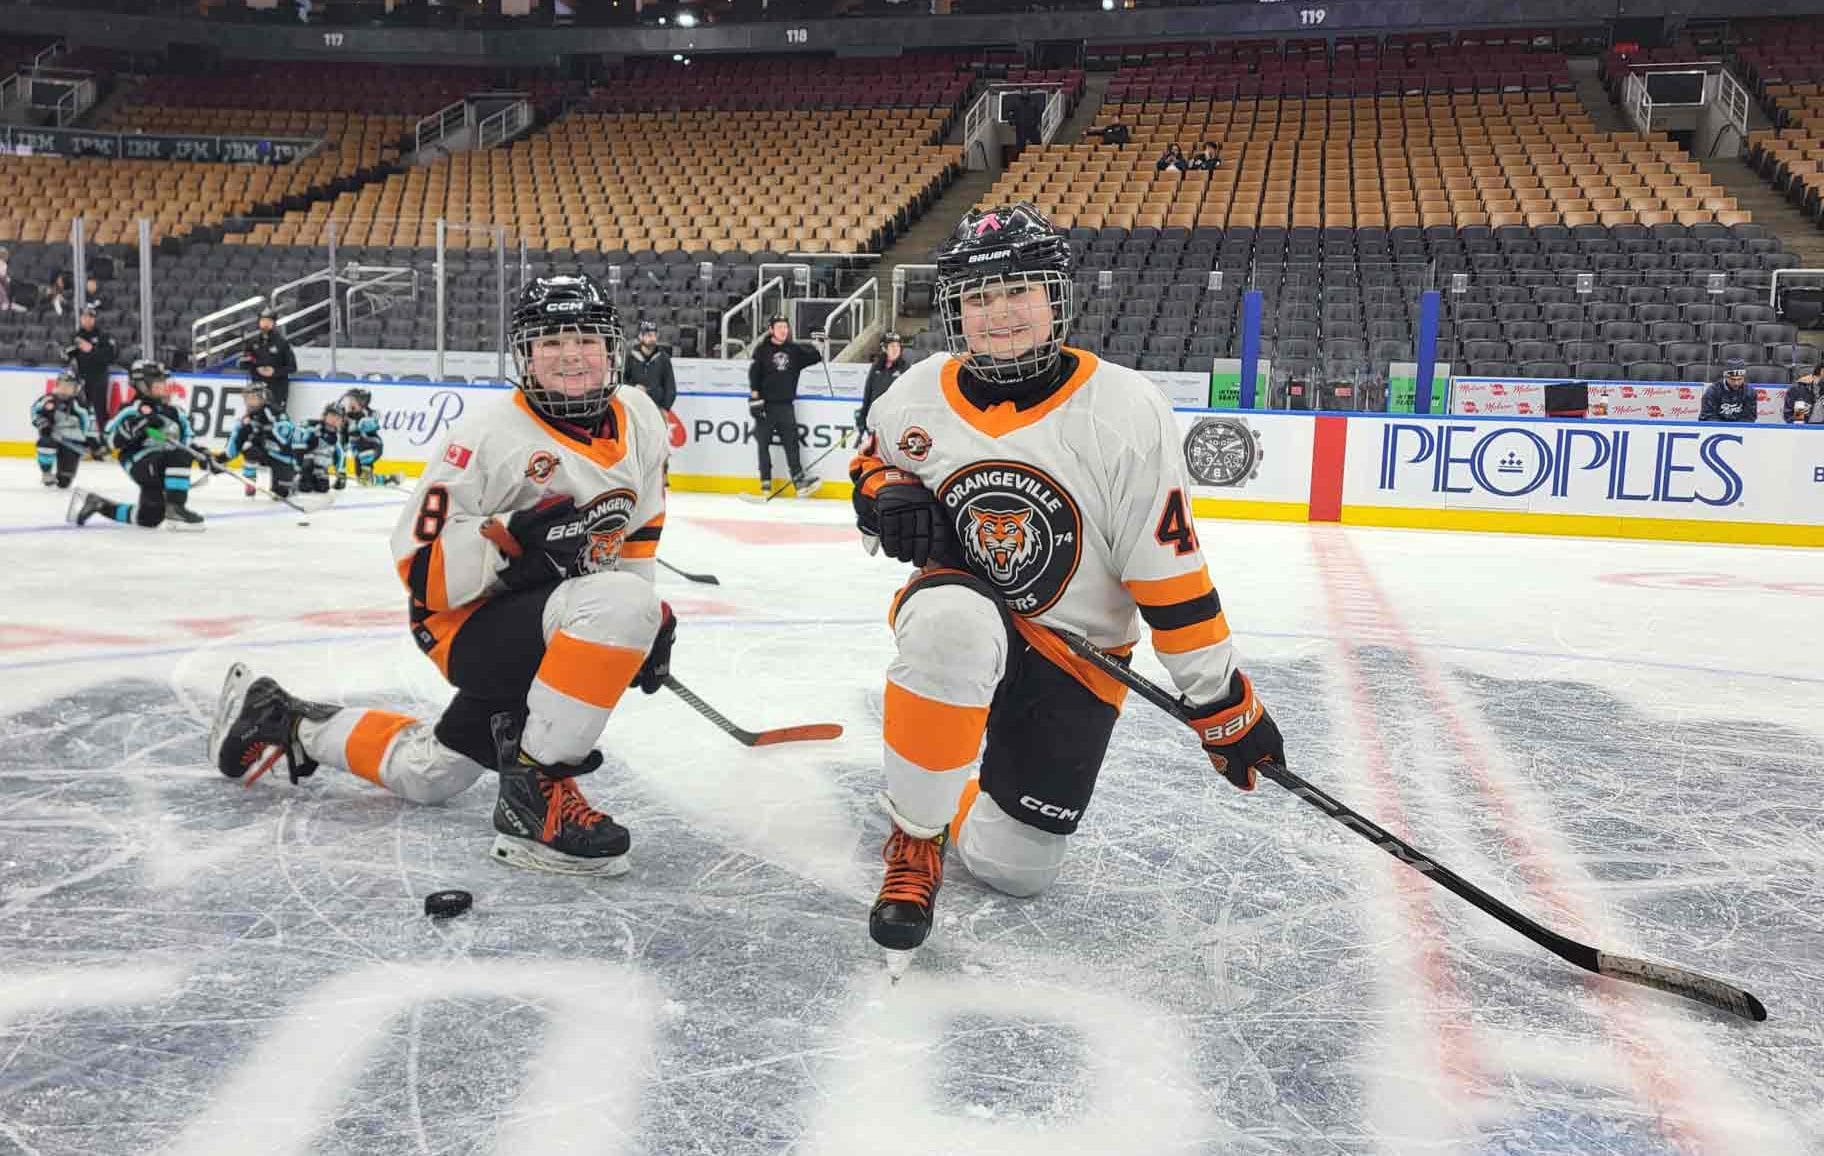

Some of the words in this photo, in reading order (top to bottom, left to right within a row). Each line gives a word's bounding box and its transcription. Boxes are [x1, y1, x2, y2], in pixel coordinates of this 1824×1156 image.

[1300, 9, 1326, 24] 119
[323, 32, 344, 47] 117
[786, 28, 808, 43] 118
[967, 249, 1012, 263] BAUER
[546, 302, 584, 313] CCM
[1379, 423, 1744, 507] PEOPLES
[945, 471, 1063, 514] ORANGEVILLE
[413, 484, 449, 542] 8
[1153, 487, 1200, 556] 4
[1055, 531, 1074, 547] 74
[499, 797, 529, 835] CCM
[1020, 795, 1081, 822] CCM
